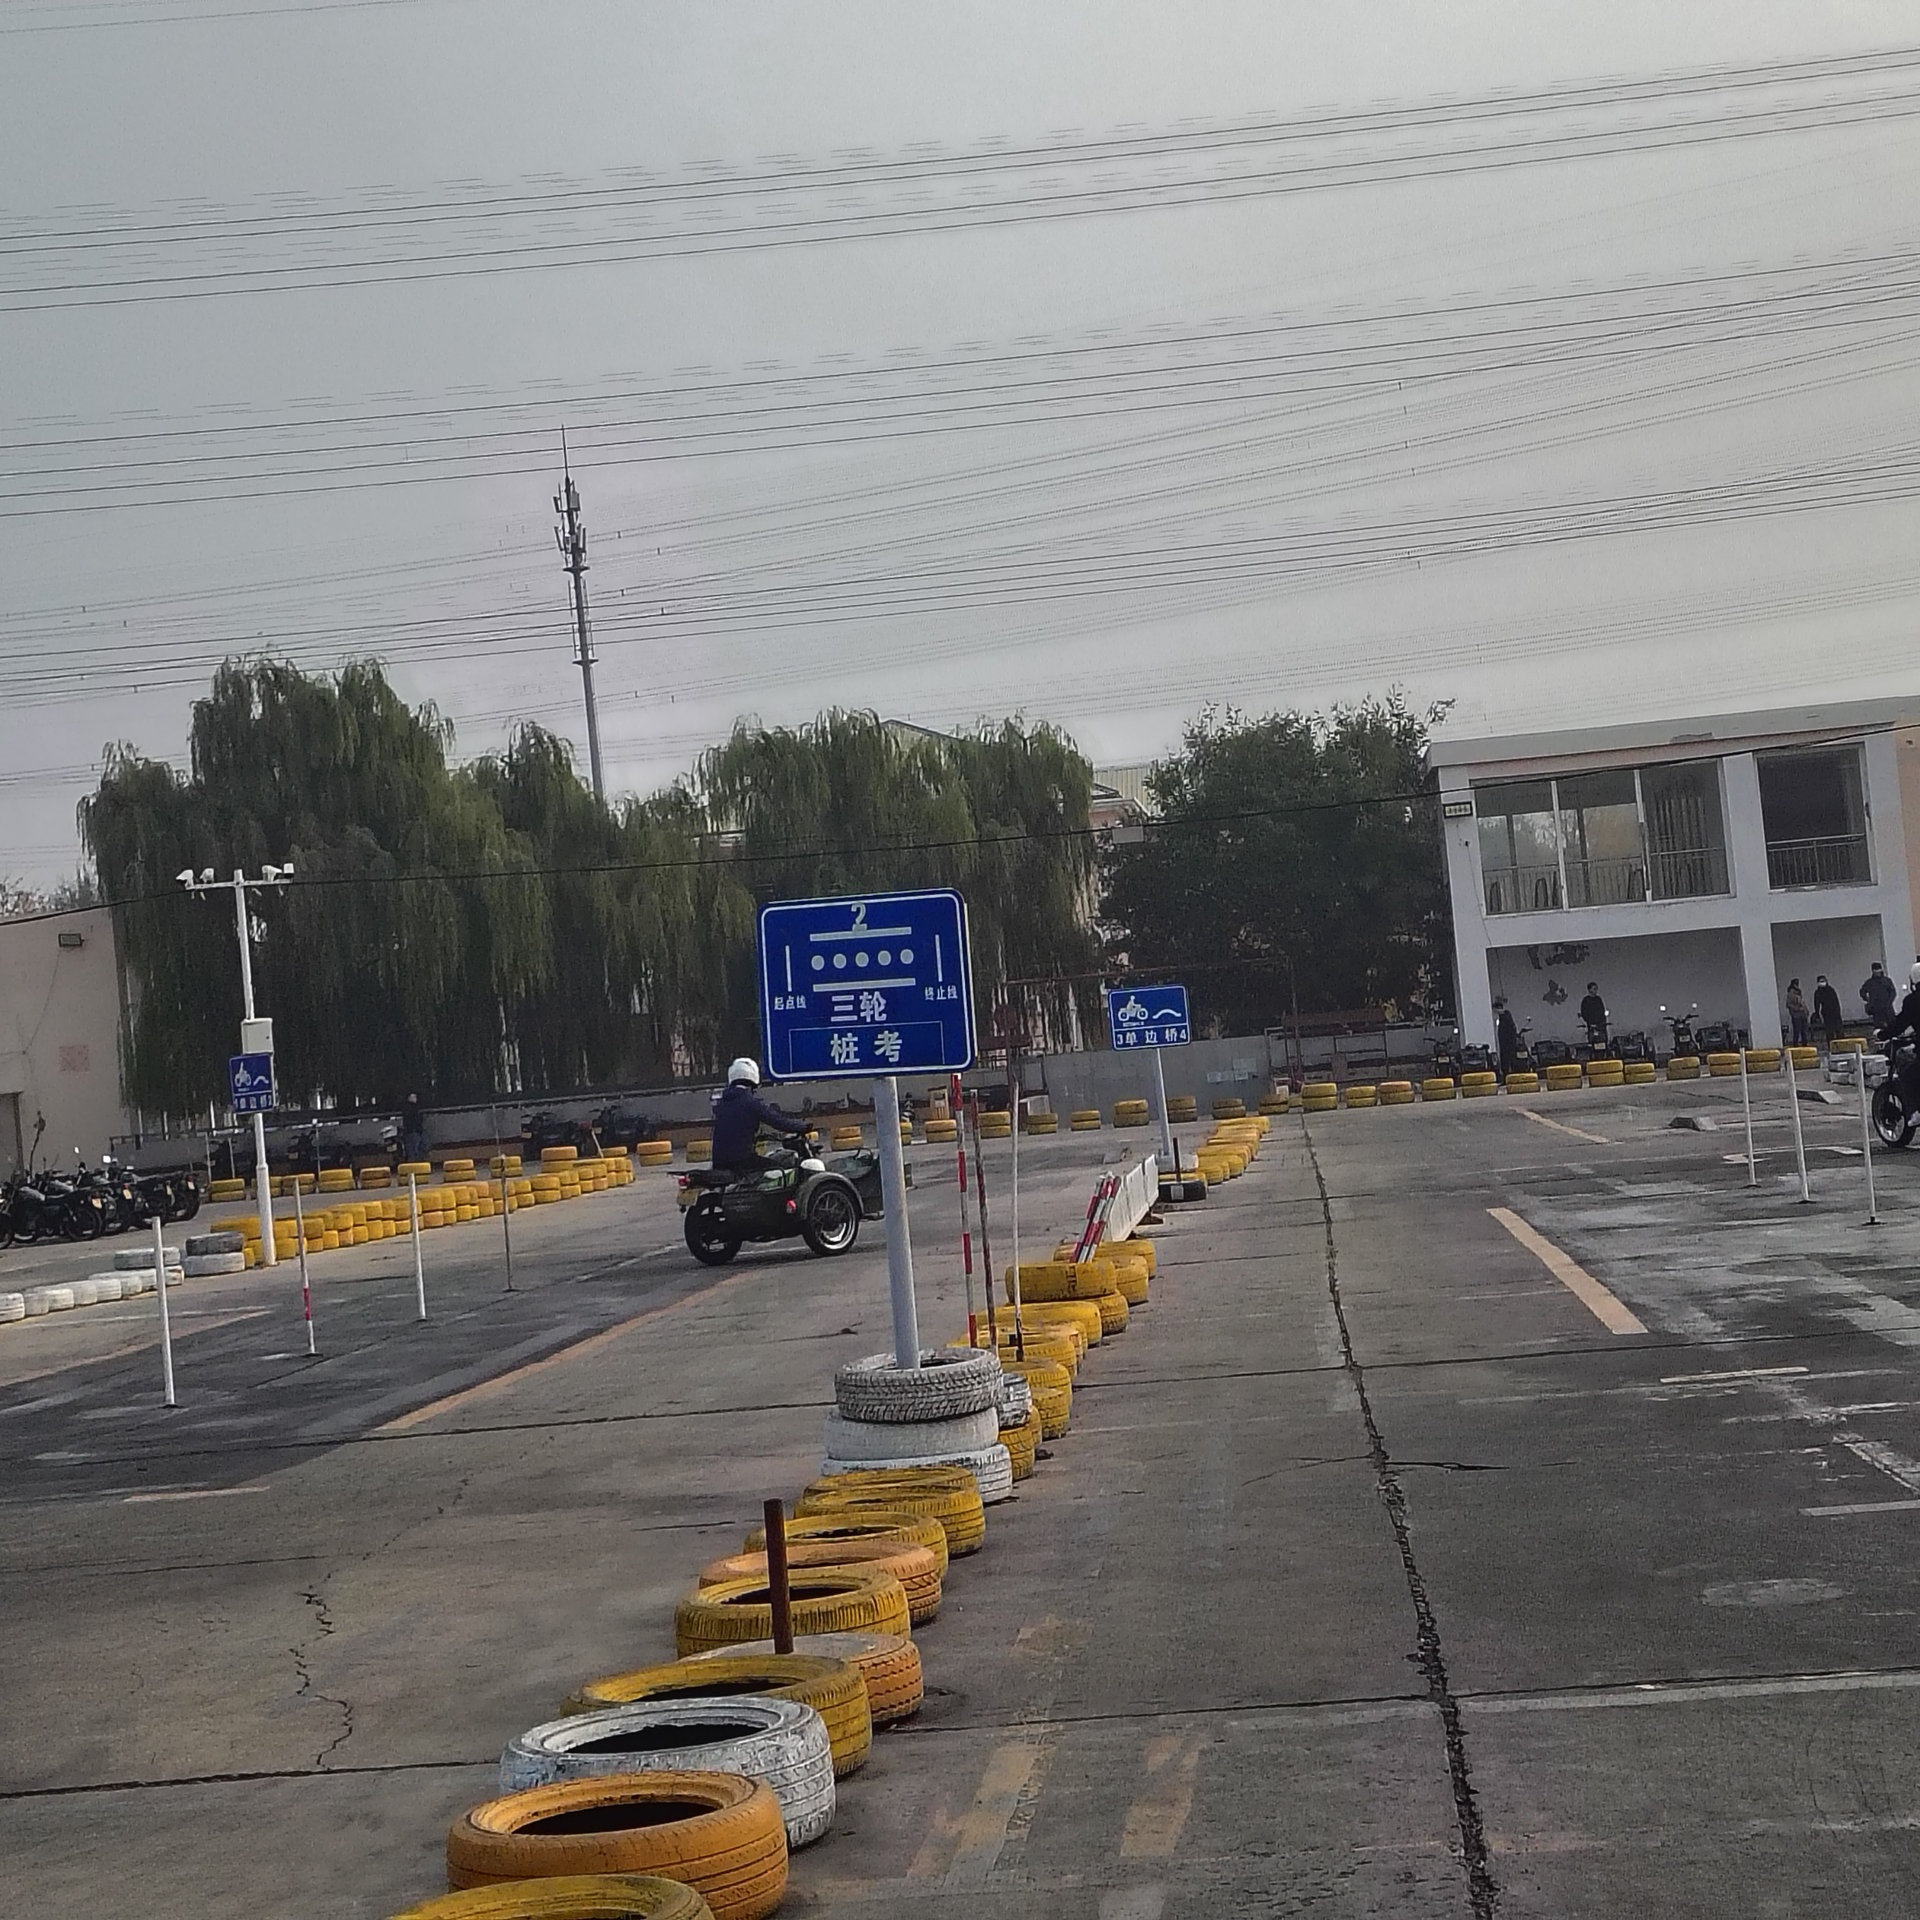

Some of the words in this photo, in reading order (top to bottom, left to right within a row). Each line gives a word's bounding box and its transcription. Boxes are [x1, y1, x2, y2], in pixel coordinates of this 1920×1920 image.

[851, 903, 868, 932] 2
[774, 996, 807, 1010] 起点线
[830, 991, 888, 1022] 三轮
[830, 1030, 903, 1065] 桩考
